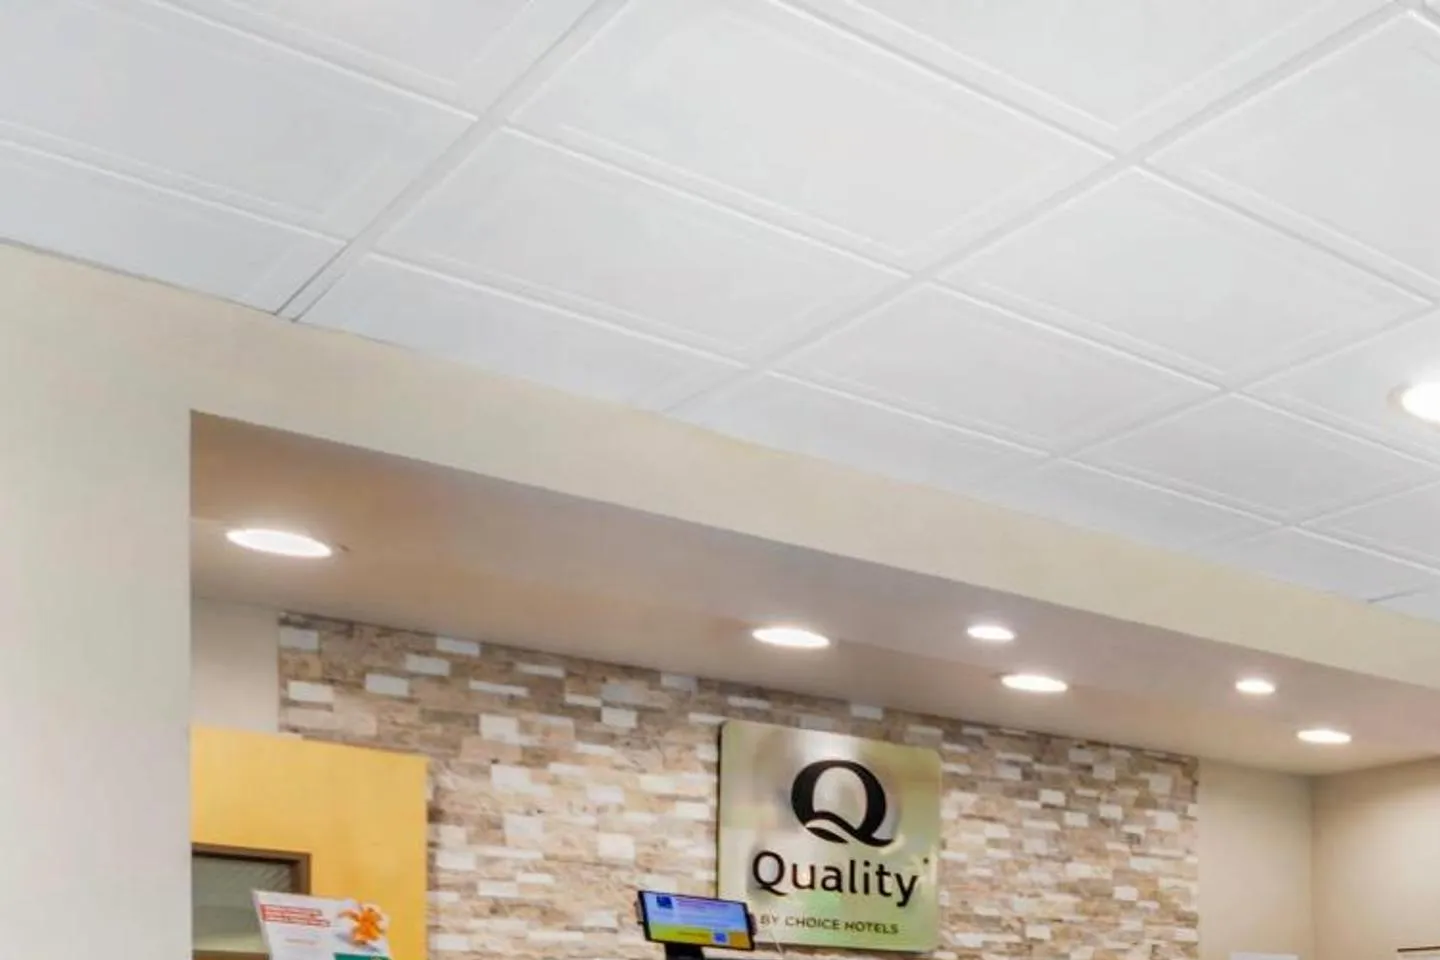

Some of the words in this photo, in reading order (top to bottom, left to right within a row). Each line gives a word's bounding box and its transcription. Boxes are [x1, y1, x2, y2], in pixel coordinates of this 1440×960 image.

[791, 760, 894, 847] Q
[752, 850, 919, 907] Quality
[760, 914, 778, 926] BY
[784, 916, 840, 930] CHOICE
[843, 921, 899, 935] HOTELS
